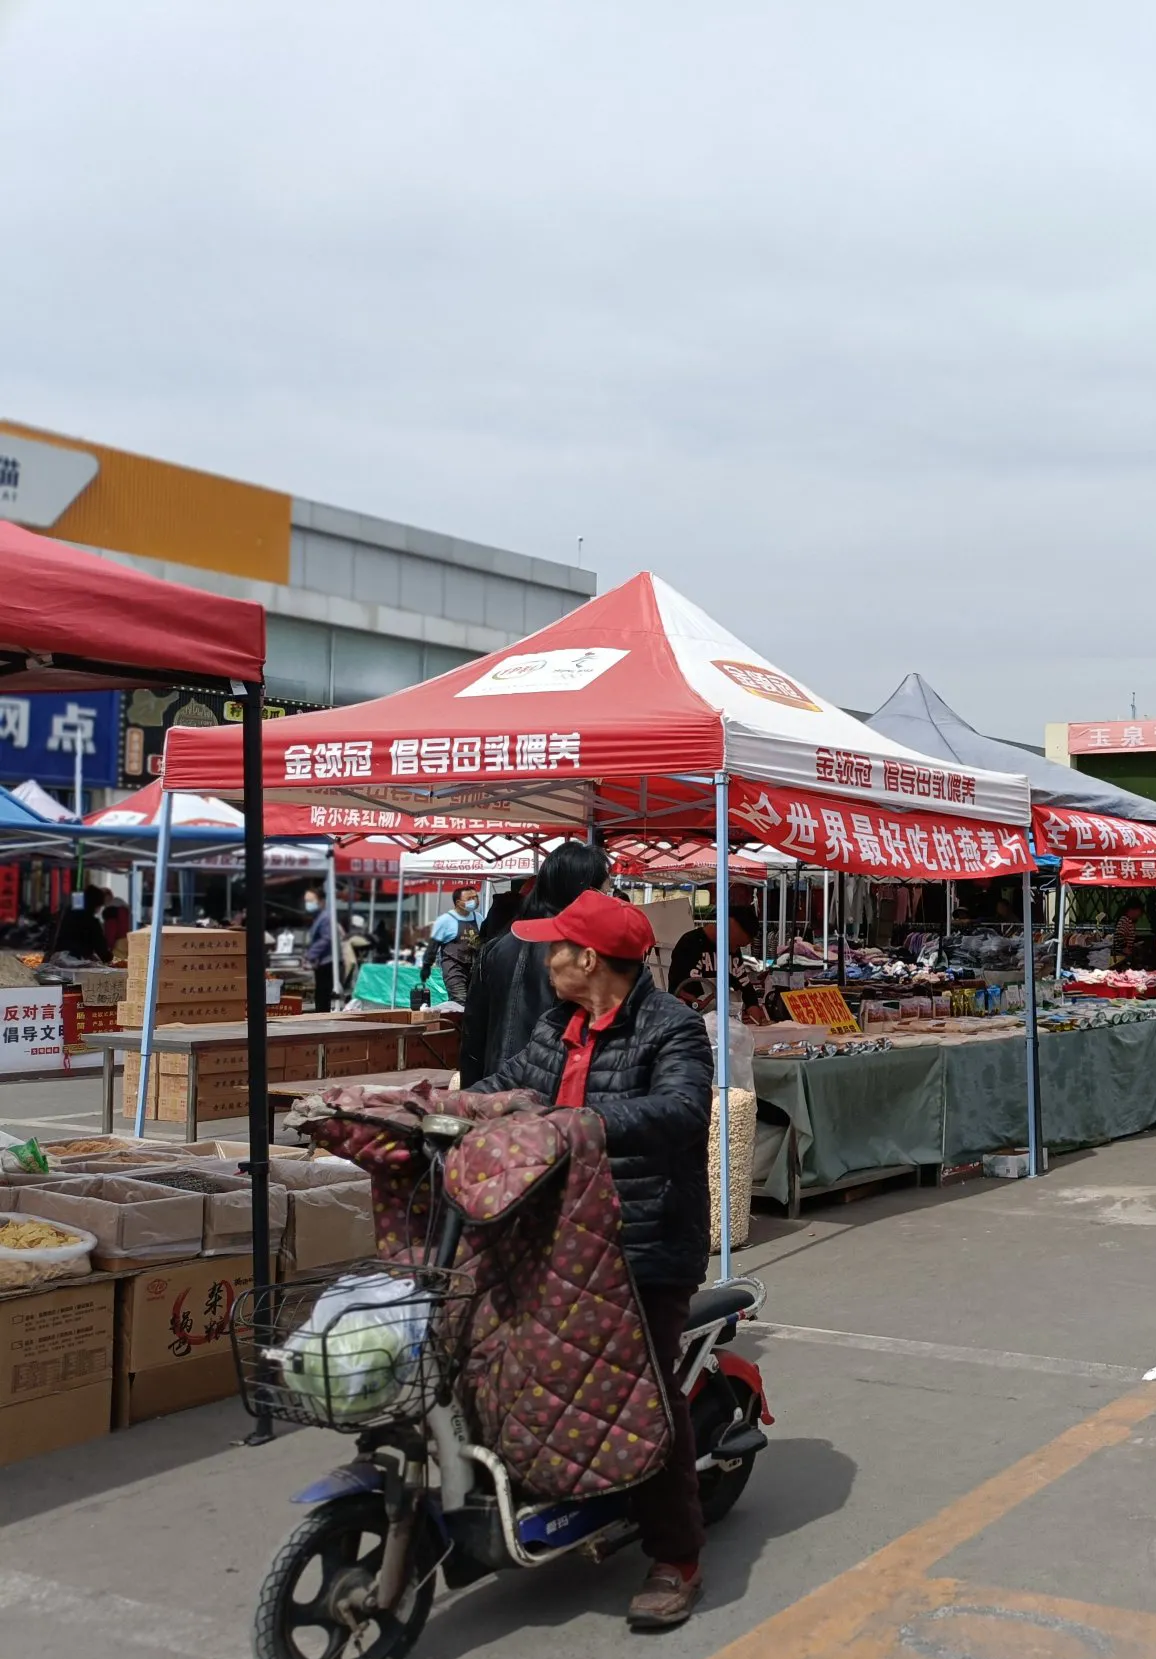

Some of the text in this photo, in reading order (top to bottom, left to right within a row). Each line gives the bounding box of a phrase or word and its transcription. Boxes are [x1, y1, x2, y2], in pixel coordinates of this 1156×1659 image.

[722, 664, 804, 699] 金领冠
[284, 732, 582, 781] 金领冠 倡导母乳喂养
[815, 747, 977, 805] 金领冠 倡导母乳喂养
[728, 791, 1028, 874] 全世界最好吃的燕麦片
